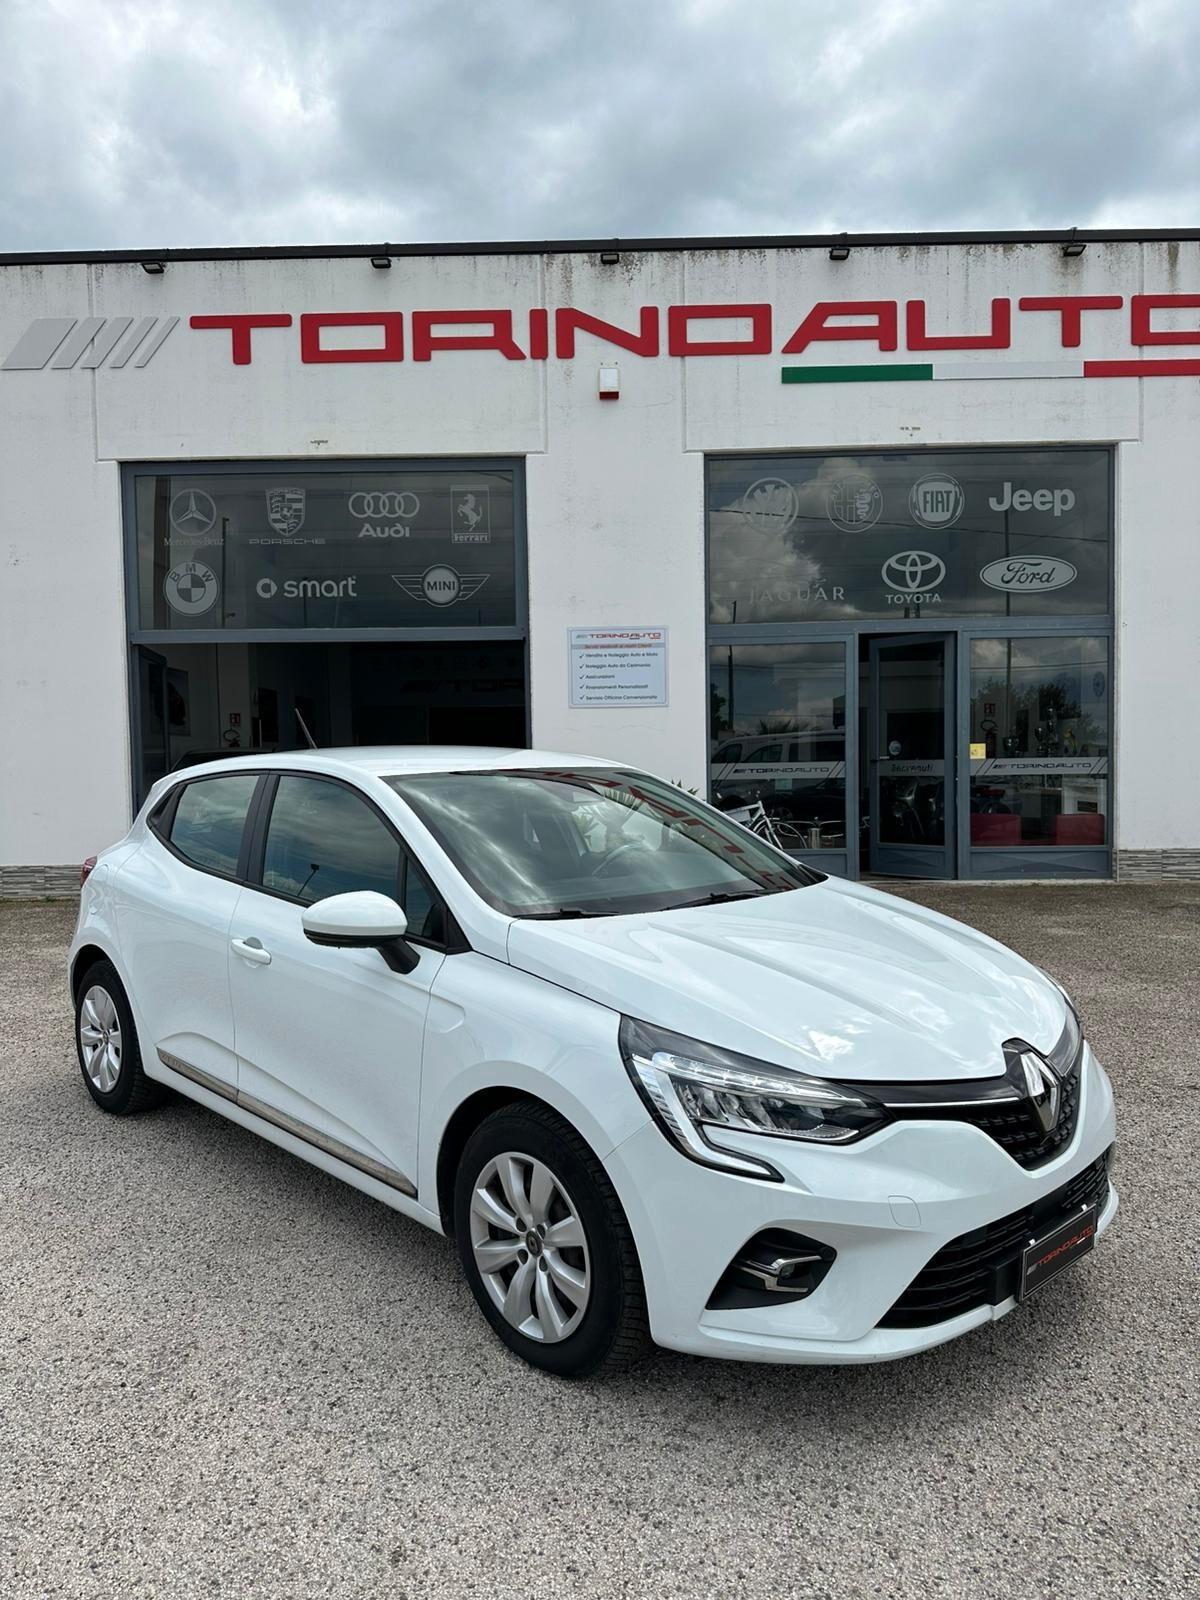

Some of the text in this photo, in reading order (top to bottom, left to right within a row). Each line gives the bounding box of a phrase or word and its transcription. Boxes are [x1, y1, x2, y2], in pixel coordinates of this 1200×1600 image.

[189, 293, 1200, 365] TORINOAUTO
[922, 489, 953, 514] FIAT
[988, 481, 1075, 516] Jeep
[357, 523, 410, 538] Audi
[169, 563, 214, 583] BMW
[1001, 560, 1056, 586] Ford
[283, 575, 357, 598] smart
[427, 580, 456, 591] MINI
[748, 586, 845, 604] JAGUAR
[885, 593, 942, 605] TOYOTA
[747, 766, 830, 774] TORINOAUTO
[1035, 1225, 1094, 1266] TORINOAUTO
